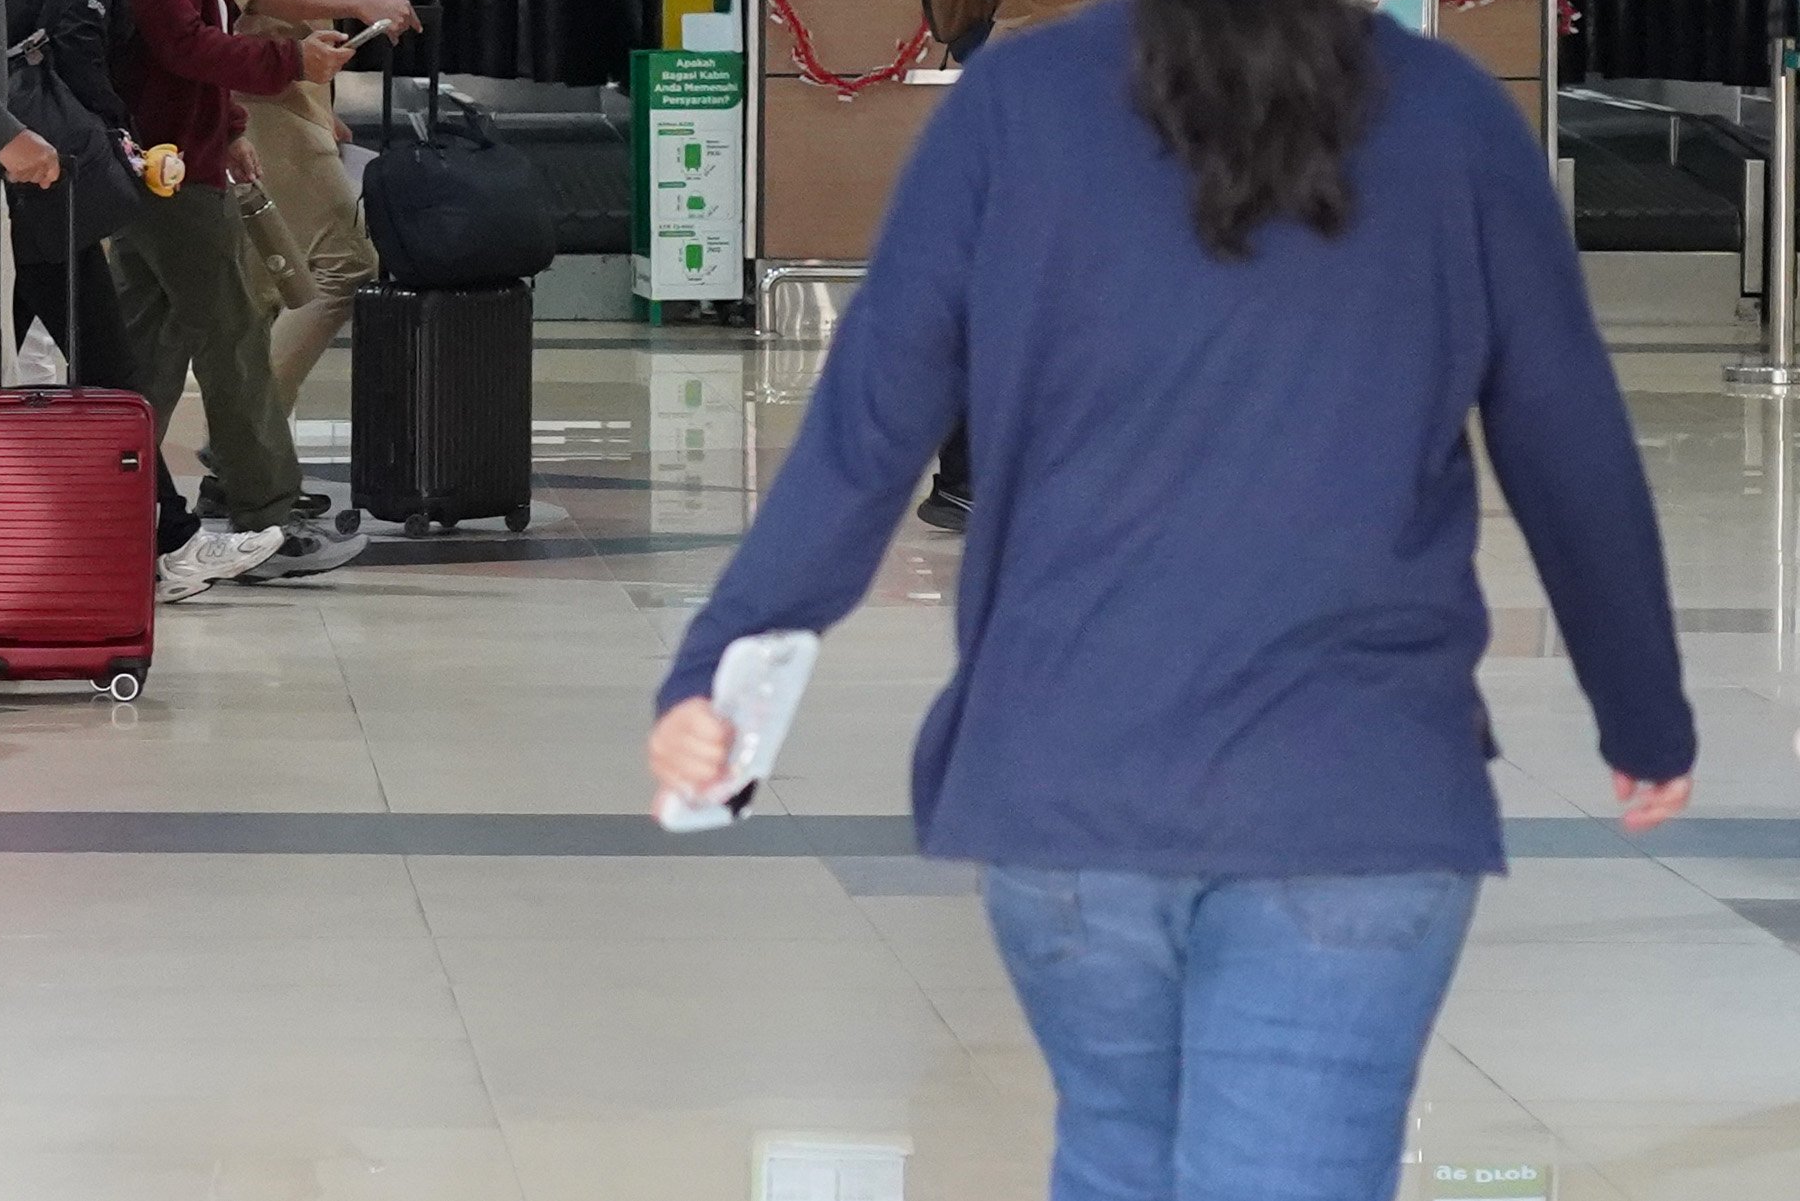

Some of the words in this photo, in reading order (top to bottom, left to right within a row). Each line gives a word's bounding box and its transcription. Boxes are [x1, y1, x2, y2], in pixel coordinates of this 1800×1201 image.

[676, 58, 716, 69] Apakah
[662, 71, 697, 81] Bagasi
[700, 71, 731, 80] Kabin
[654, 83, 682, 92] Anda
